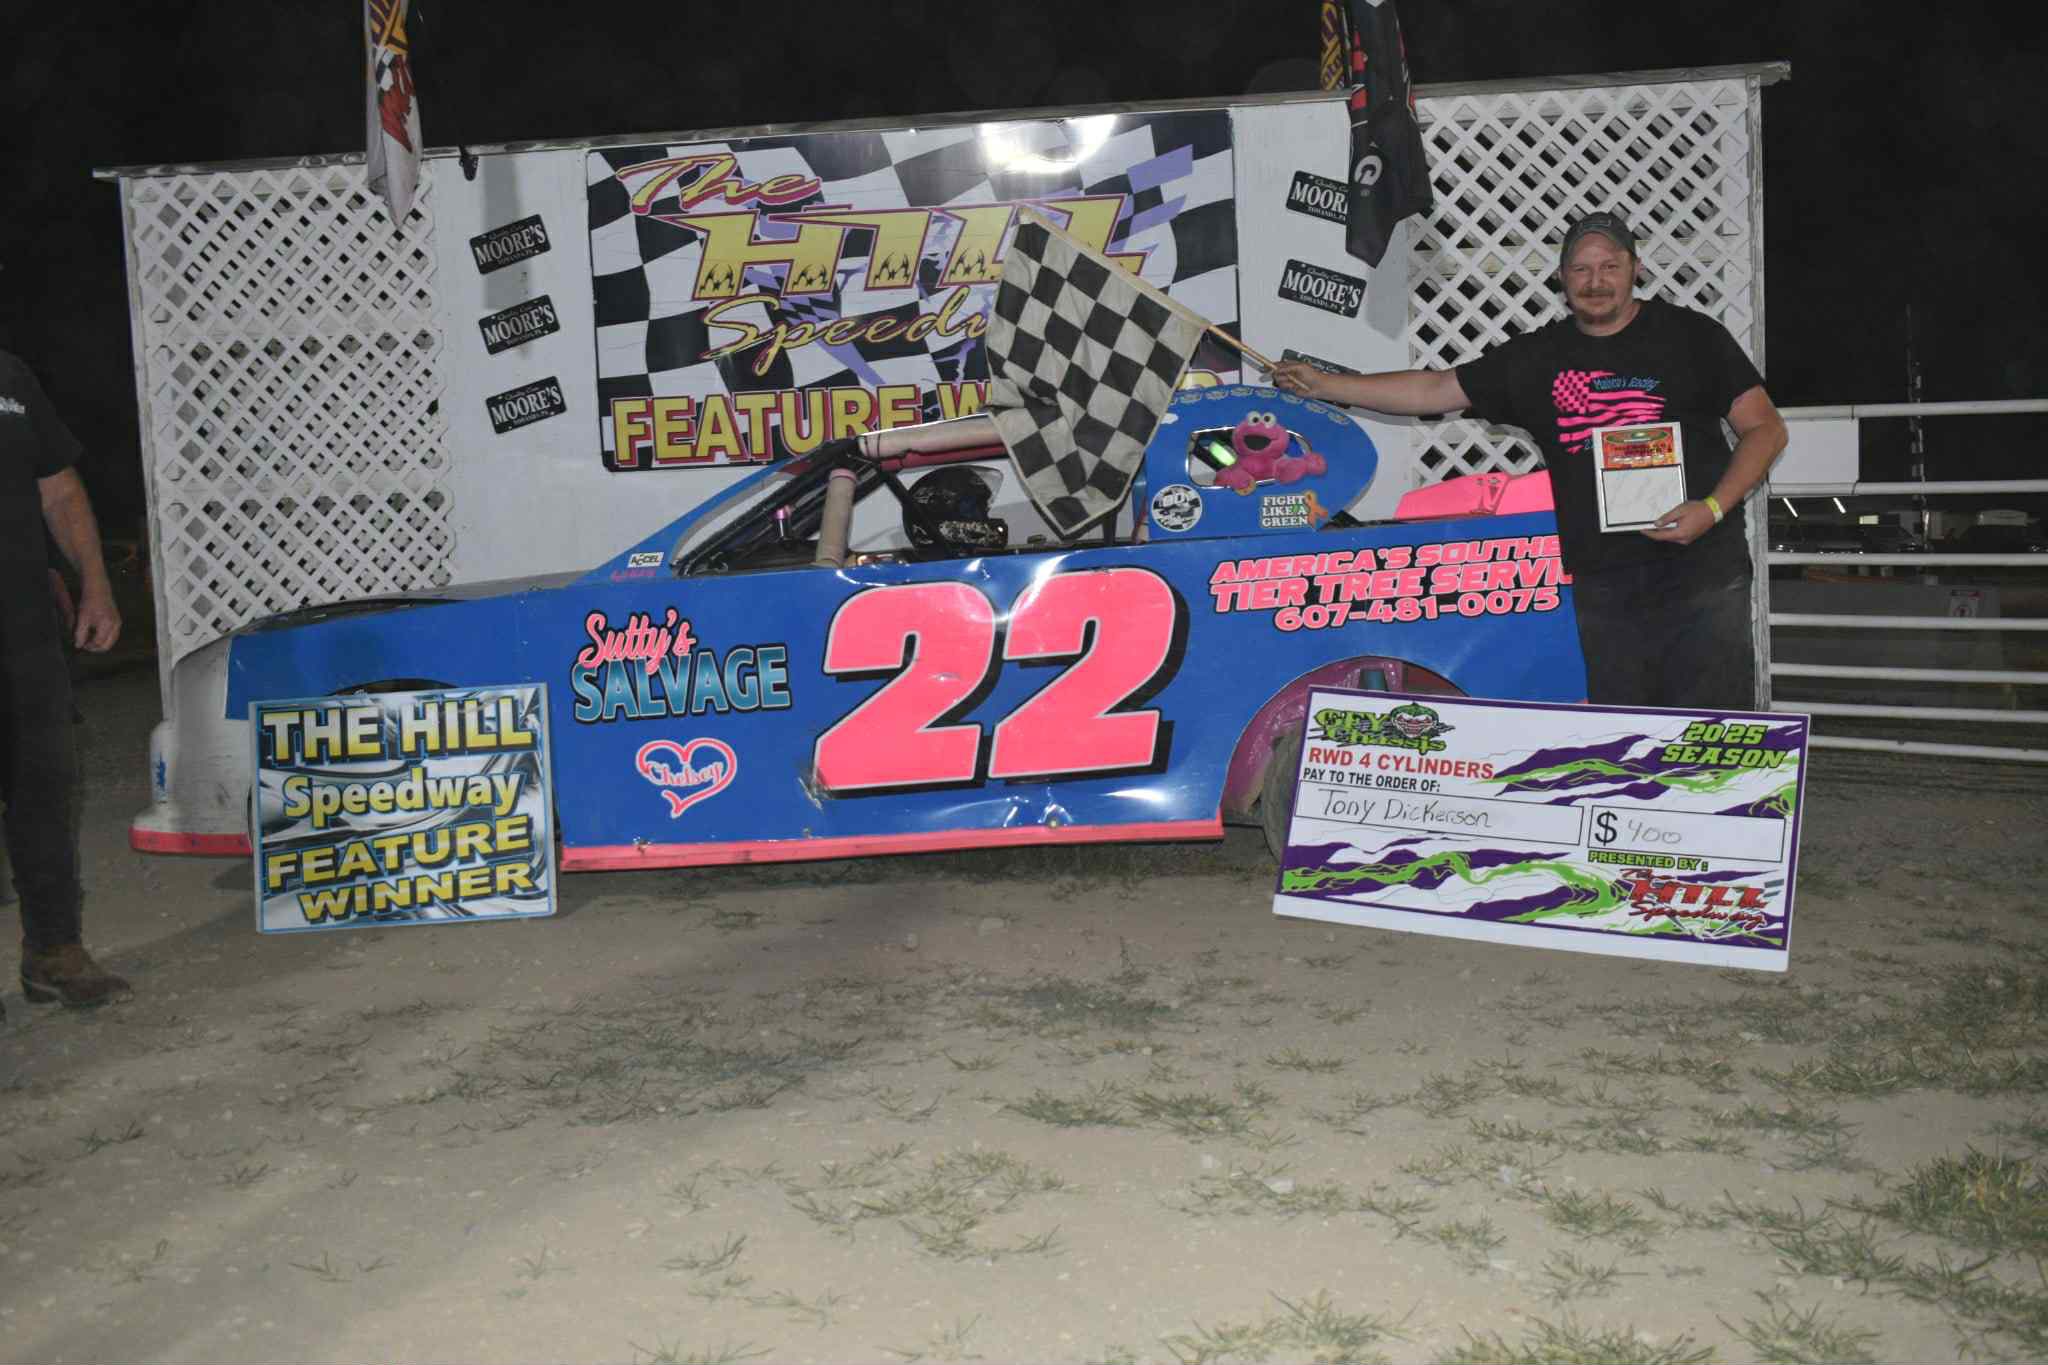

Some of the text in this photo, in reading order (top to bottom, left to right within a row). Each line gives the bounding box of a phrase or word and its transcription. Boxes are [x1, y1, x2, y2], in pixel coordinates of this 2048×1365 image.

[616, 152, 822, 216] The
[1290, 181, 1348, 215] MOOR
[475, 223, 546, 265] MOORE'S
[1282, 269, 1362, 308] MOORE'S
[483, 304, 555, 346] MOORE'S
[701, 285, 989, 377] Speed
[491, 386, 561, 425] MOORE'S
[611, 383, 922, 466] FEATURE
[1262, 504, 1308, 516] LIKE A
[1263, 495, 1306, 506] FIGHT
[1262, 516, 1309, 527] GREEN
[1209, 534, 1562, 584] AMERICA'S SOUTHE
[1210, 556, 1574, 612] TIER TREE SERVI
[1274, 586, 1561, 631] 607-481-0075
[578, 608, 697, 676] Sutty's
[571, 645, 792, 723] SALVAGE
[812, 567, 1182, 793] 22
[262, 697, 533, 761] THE HILL
[1681, 721, 1768, 745] 2025
[1308, 747, 1495, 780] RWD 4 CYLINDERS
[1660, 743, 1788, 769] SEASON
[283, 767, 521, 828] Speedway
[1303, 767, 1441, 793] PAY TO THE ORDER OF:
[1318, 788, 1377, 825] Tony
[1594, 810, 1619, 847] $
[1627, 818, 1683, 845] 400
[266, 815, 531, 889] FEATURE
[1588, 850, 1676, 869] PRESENTED
[298, 861, 536, 921] WINNER
[1629, 878, 1770, 909] HILL
[1628, 899, 1768, 931] Speedway
